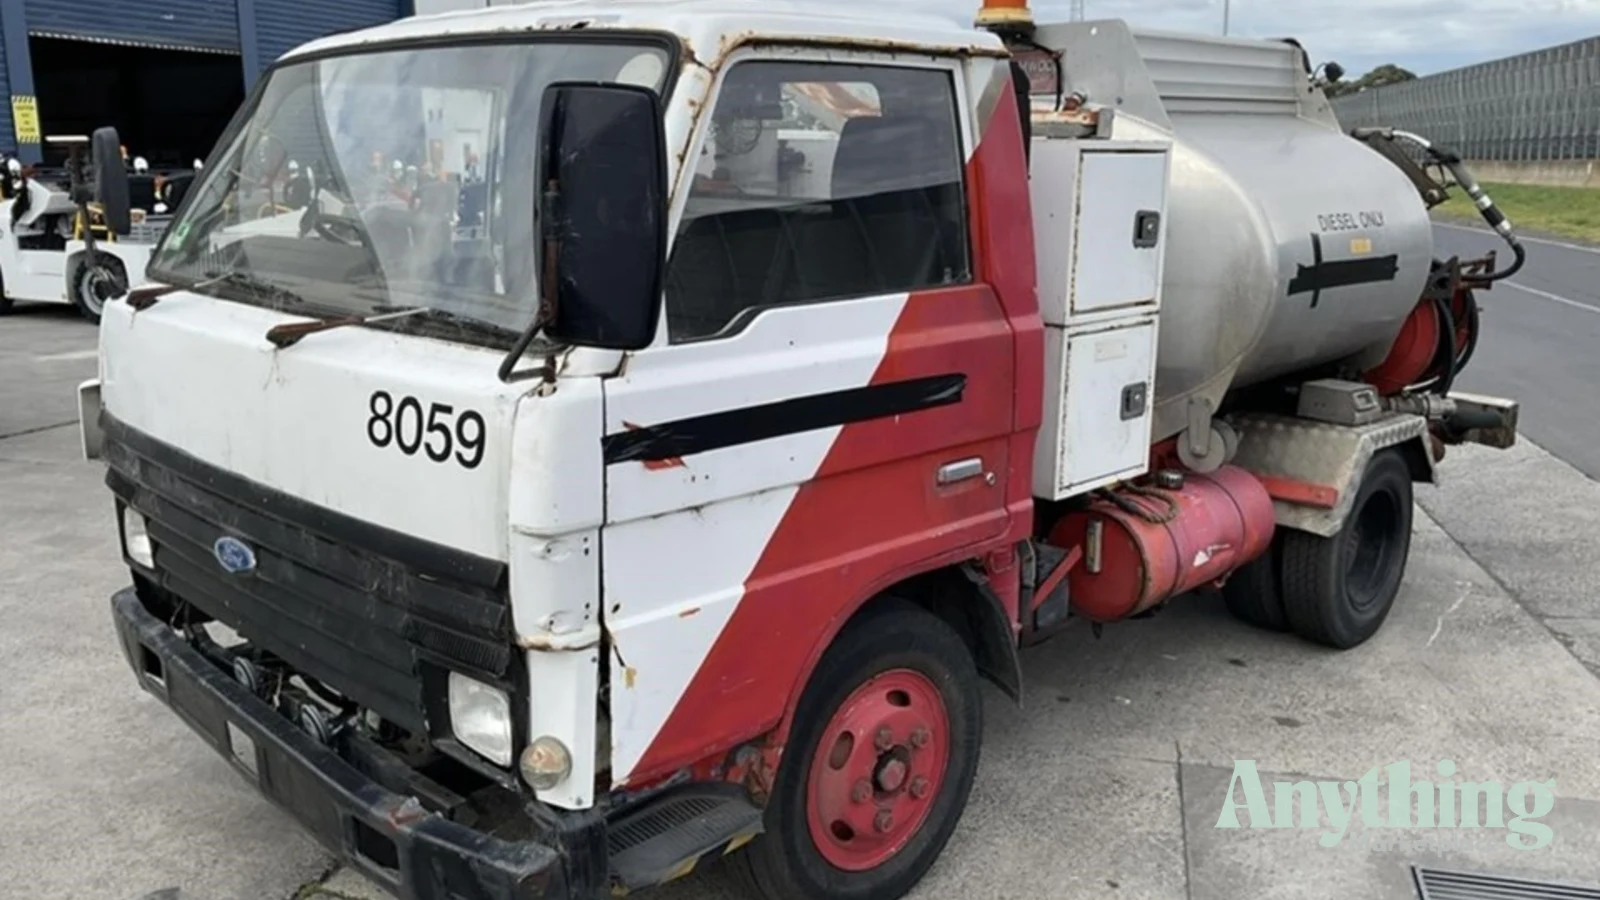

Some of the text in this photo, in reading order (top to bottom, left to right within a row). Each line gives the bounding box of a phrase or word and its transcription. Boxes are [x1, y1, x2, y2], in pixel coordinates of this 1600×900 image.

[1317, 209, 1385, 232] DIESEL ONLY
[367, 390, 486, 470] 8059
